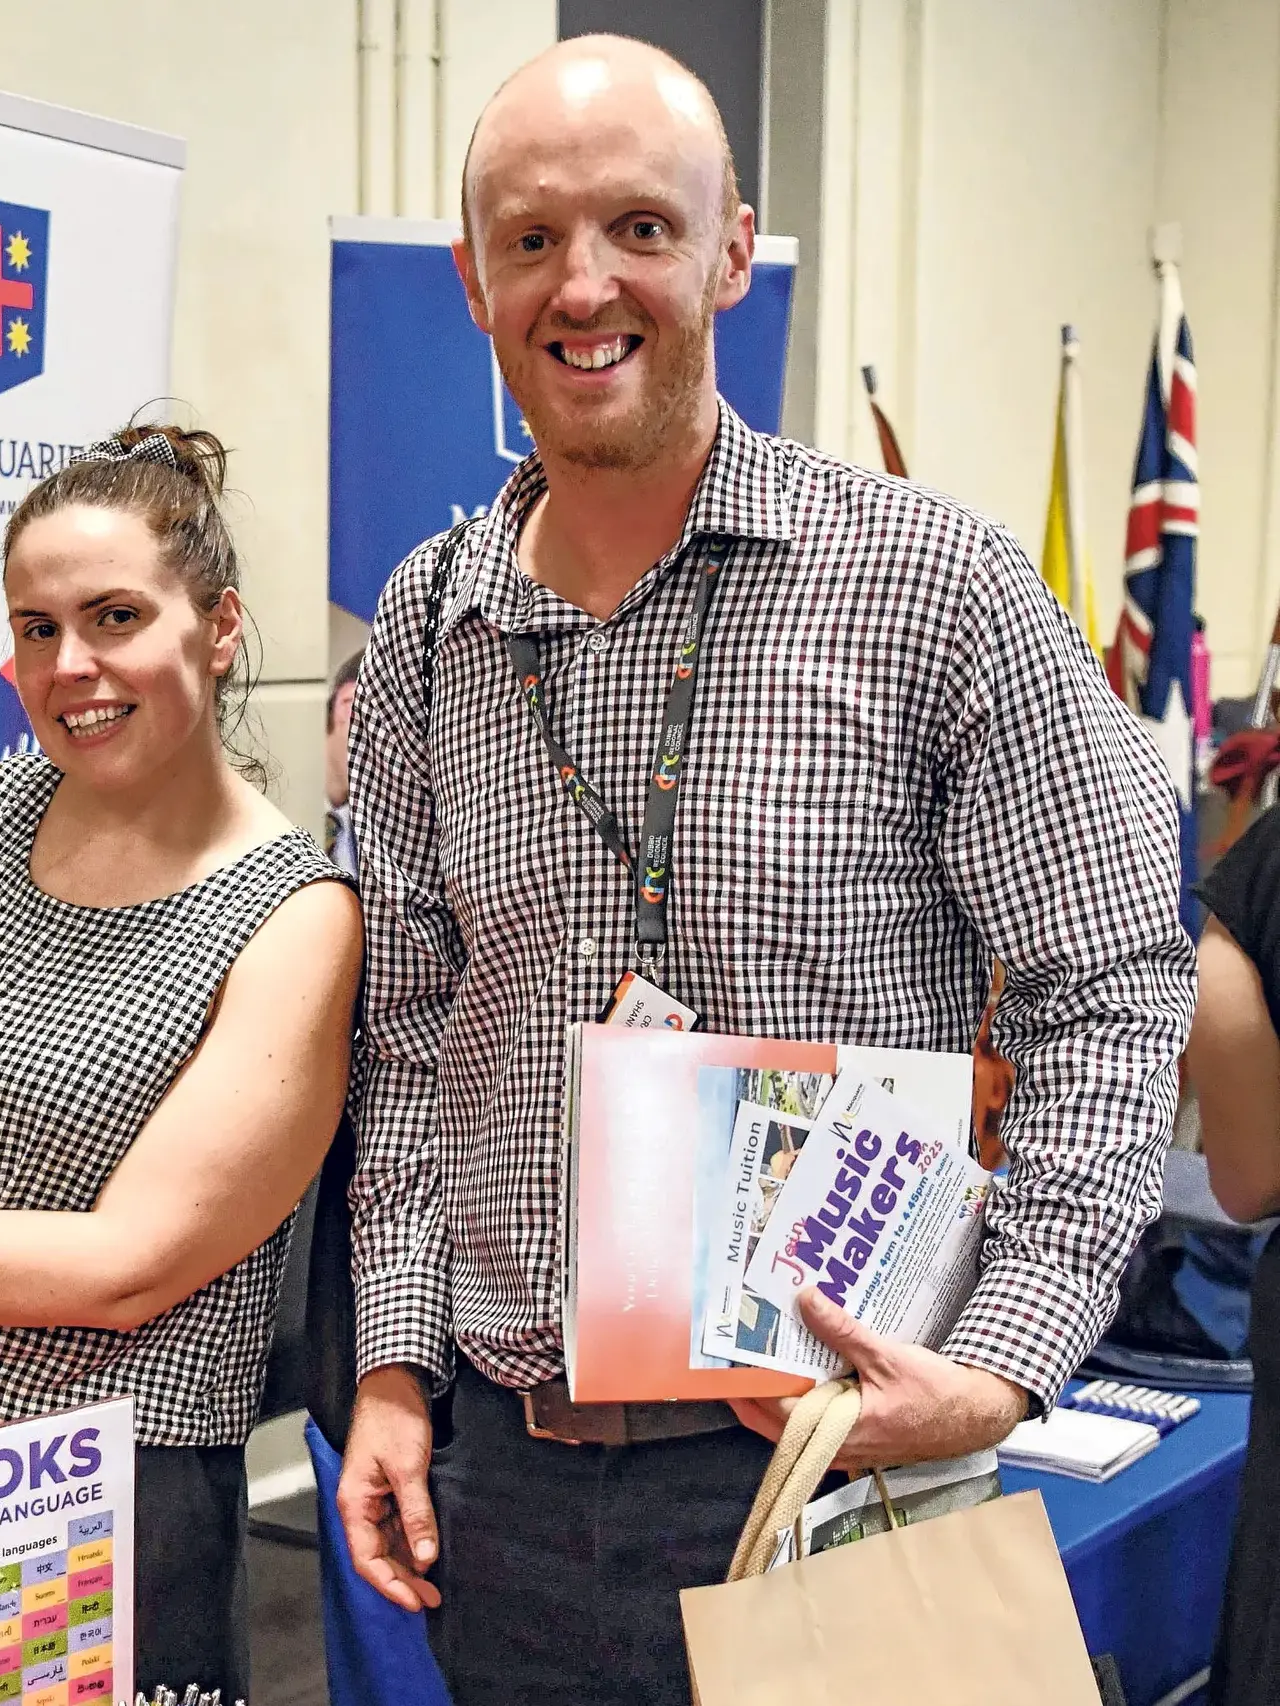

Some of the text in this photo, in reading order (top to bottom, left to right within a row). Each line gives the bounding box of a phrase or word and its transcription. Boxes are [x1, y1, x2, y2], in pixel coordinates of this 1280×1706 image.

[669, 724, 679, 755] REGIONAL
[675, 723, 684, 751] COUNCIL
[647, 835, 655, 859] DUBBO
[653, 835, 662, 868] REGIONAL
[660, 835, 668, 864] COUNCIL
[640, 1015, 652, 1028] CR
[916, 1140, 943, 1175] 2025
[727, 1122, 761, 1263] Music Tuition
[794, 1129, 882, 1272] Music
[816, 1131, 922, 1308] Makers
[876, 1285, 884, 1297] the
[883, 1245, 904, 1284] Macquarie
[903, 1183, 935, 1243] Conservatorium
[935, 1153, 949, 1176] Dubbo
[771, 1217, 808, 1286] Join
[855, 1176, 929, 1319] uesdays 4pm to 4.45pm
[2, 1535, 58, 1558] languages
[37, 1562, 53, 1574] 中文
[80, 1627, 102, 1641] 한국어
